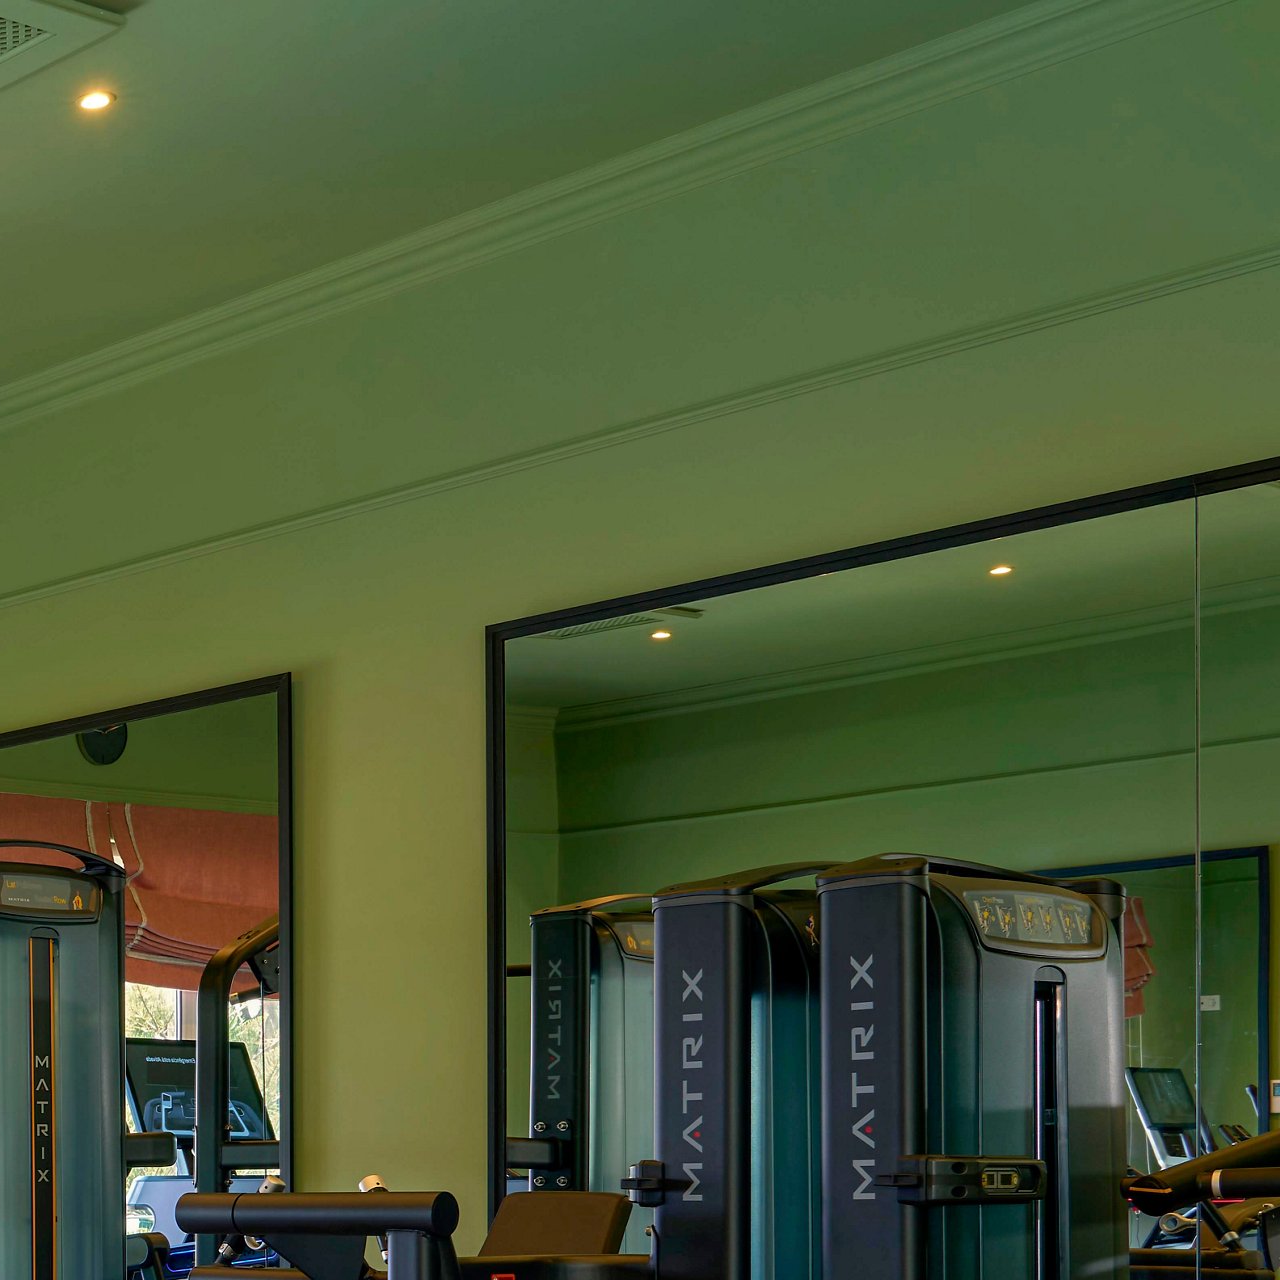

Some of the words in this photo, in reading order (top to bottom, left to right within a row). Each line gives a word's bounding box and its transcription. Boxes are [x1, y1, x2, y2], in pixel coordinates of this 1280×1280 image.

[34, 1055, 49, 1183] MATRIX
[682, 967, 703, 1202] MATRIX
[850, 953, 876, 1200] MATRIX
